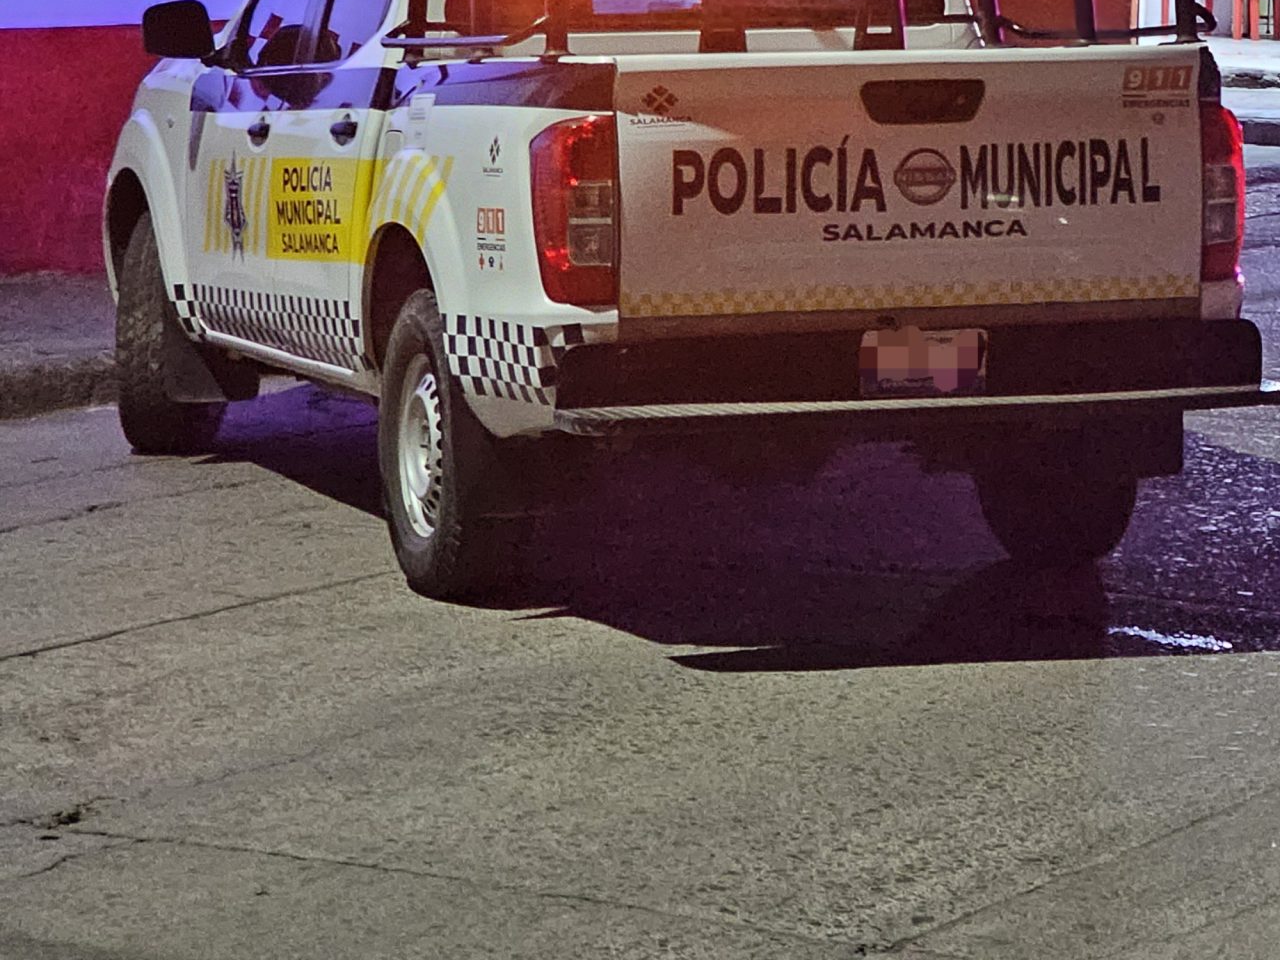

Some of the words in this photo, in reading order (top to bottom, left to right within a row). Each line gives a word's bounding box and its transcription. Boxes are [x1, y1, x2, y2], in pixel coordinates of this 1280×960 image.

[1126, 69, 1187, 89] 911
[283, 161, 333, 192] POLICÍA
[672, 135, 887, 216] POLICÍA
[960, 137, 1161, 209] MUNICIPAL
[276, 199, 341, 226] MUNICIPAL
[822, 219, 1028, 241] SALAMANCA
[281, 232, 339, 254] SALAMANCA
